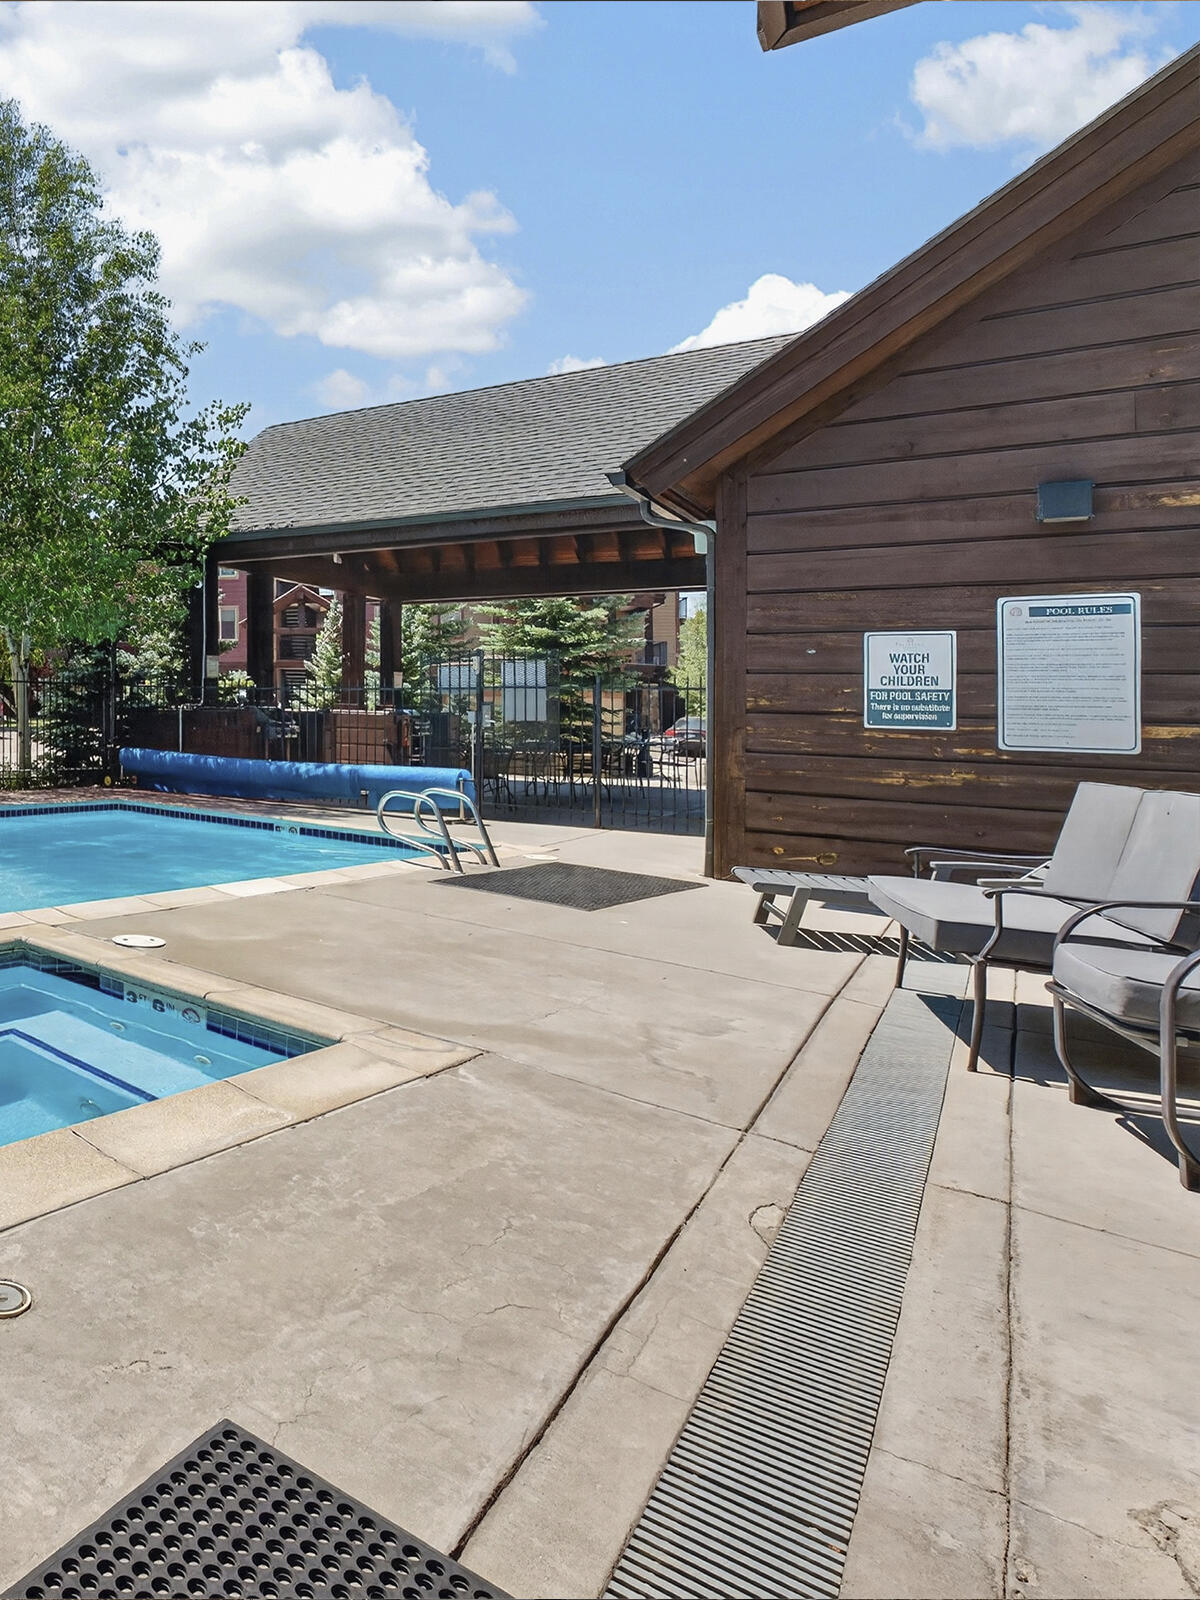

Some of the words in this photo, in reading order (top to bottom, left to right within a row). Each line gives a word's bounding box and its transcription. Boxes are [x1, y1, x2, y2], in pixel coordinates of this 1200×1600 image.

[1046, 607, 1075, 616] POOL
[1077, 606, 1113, 615] RULES
[889, 653, 930, 664] WATCH
[893, 664, 925, 675] YOUR
[880, 675, 939, 686] CHILDREN
[870, 691, 888, 701] FOR
[889, 691, 914, 701] POOL
[915, 691, 950, 701] SAFETY
[870, 702, 892, 711] There
[892, 703, 900, 711] is
[911, 703, 951, 712] substitute
[882, 712, 893, 720] for
[893, 712, 938, 721] supervision
